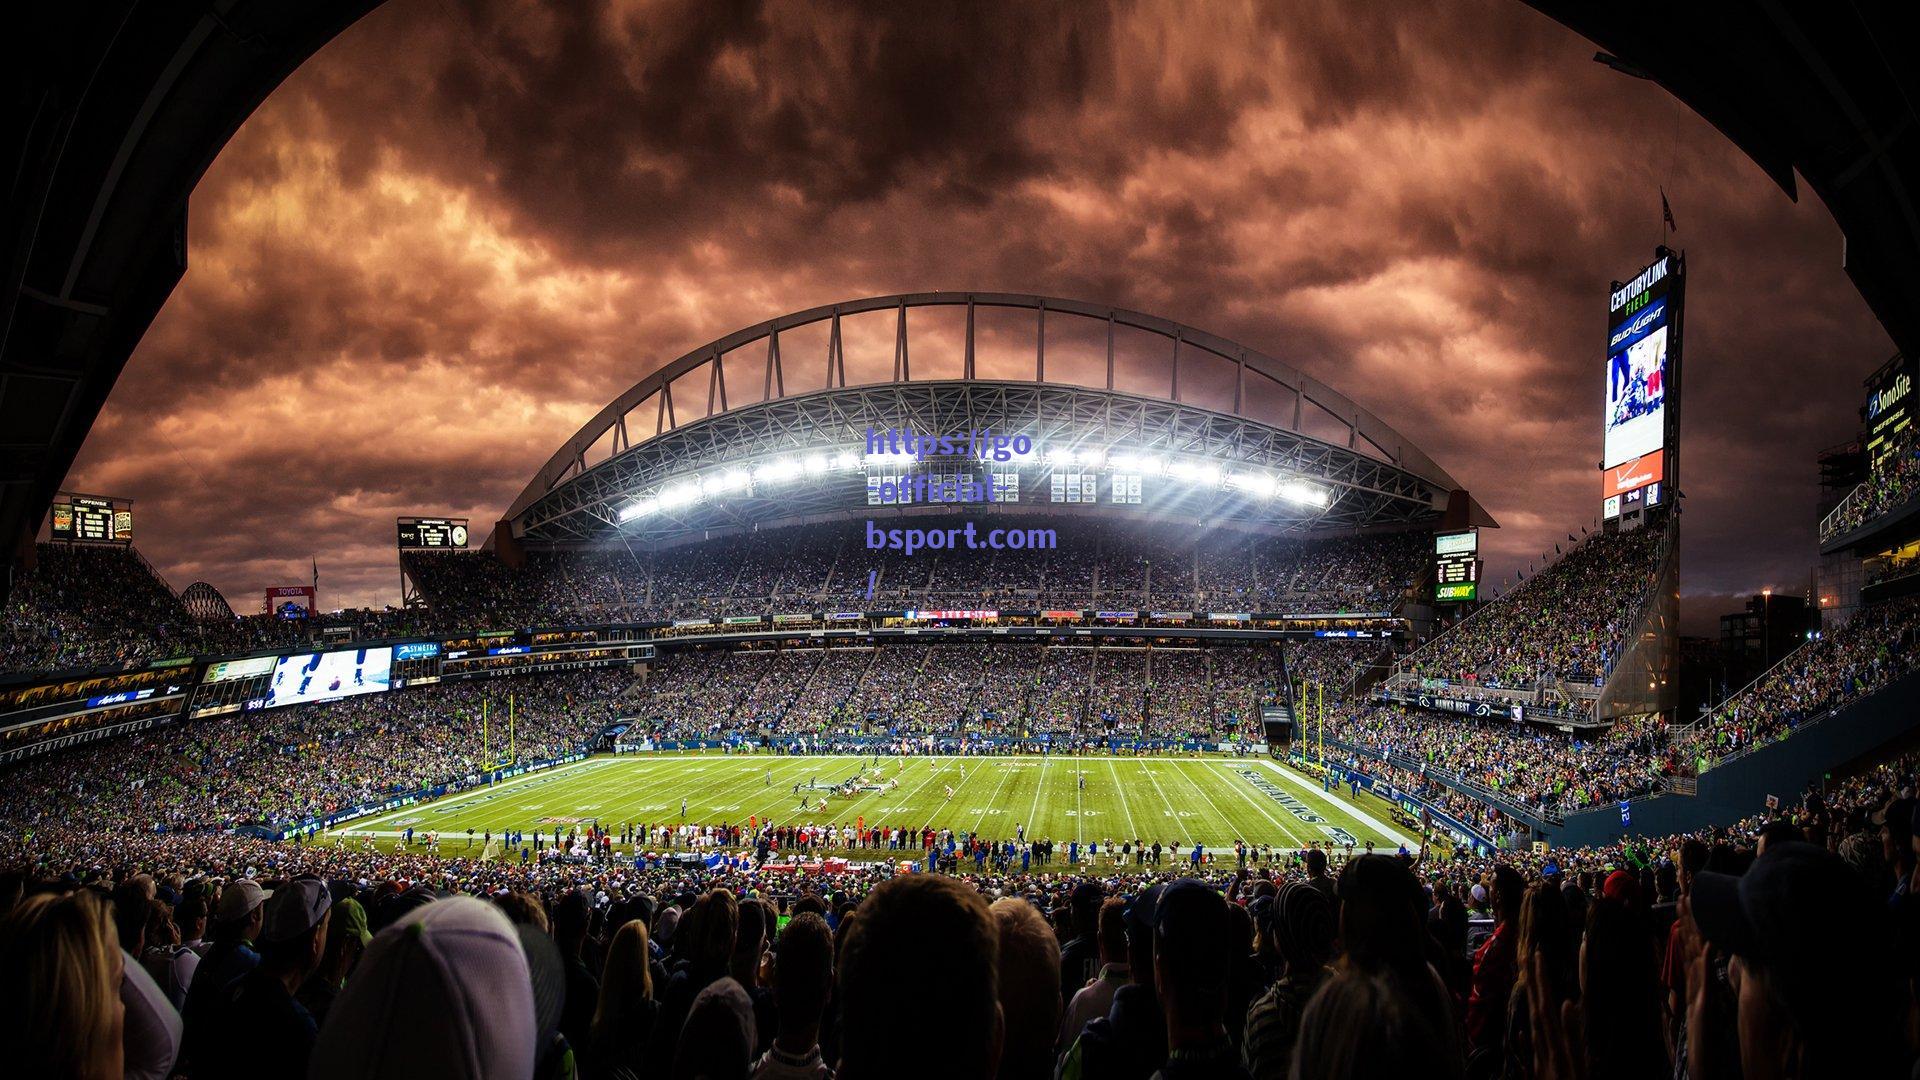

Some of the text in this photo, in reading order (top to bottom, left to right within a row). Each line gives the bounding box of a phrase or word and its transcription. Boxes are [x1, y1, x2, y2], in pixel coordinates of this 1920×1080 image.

[1610, 256, 1668, 312] CENTURYLINK
[1625, 290, 1650, 316] FIELD
[1610, 329, 1631, 347] BUD
[1877, 373, 1911, 414] SonoSite
[1873, 407, 1905, 434] DEFENSE
[80, 499, 107, 507] OFFENSE
[401, 532, 415, 540] bing
[278, 587, 304, 596] TOYOTA
[1437, 585, 1475, 599] SUBWAY
[409, 643, 438, 653] SYMETRA
[490, 657, 609, 677] HOME OF THE 12TH MAN
[9, 720, 153, 762] TO CENTURYLINK FIELD
